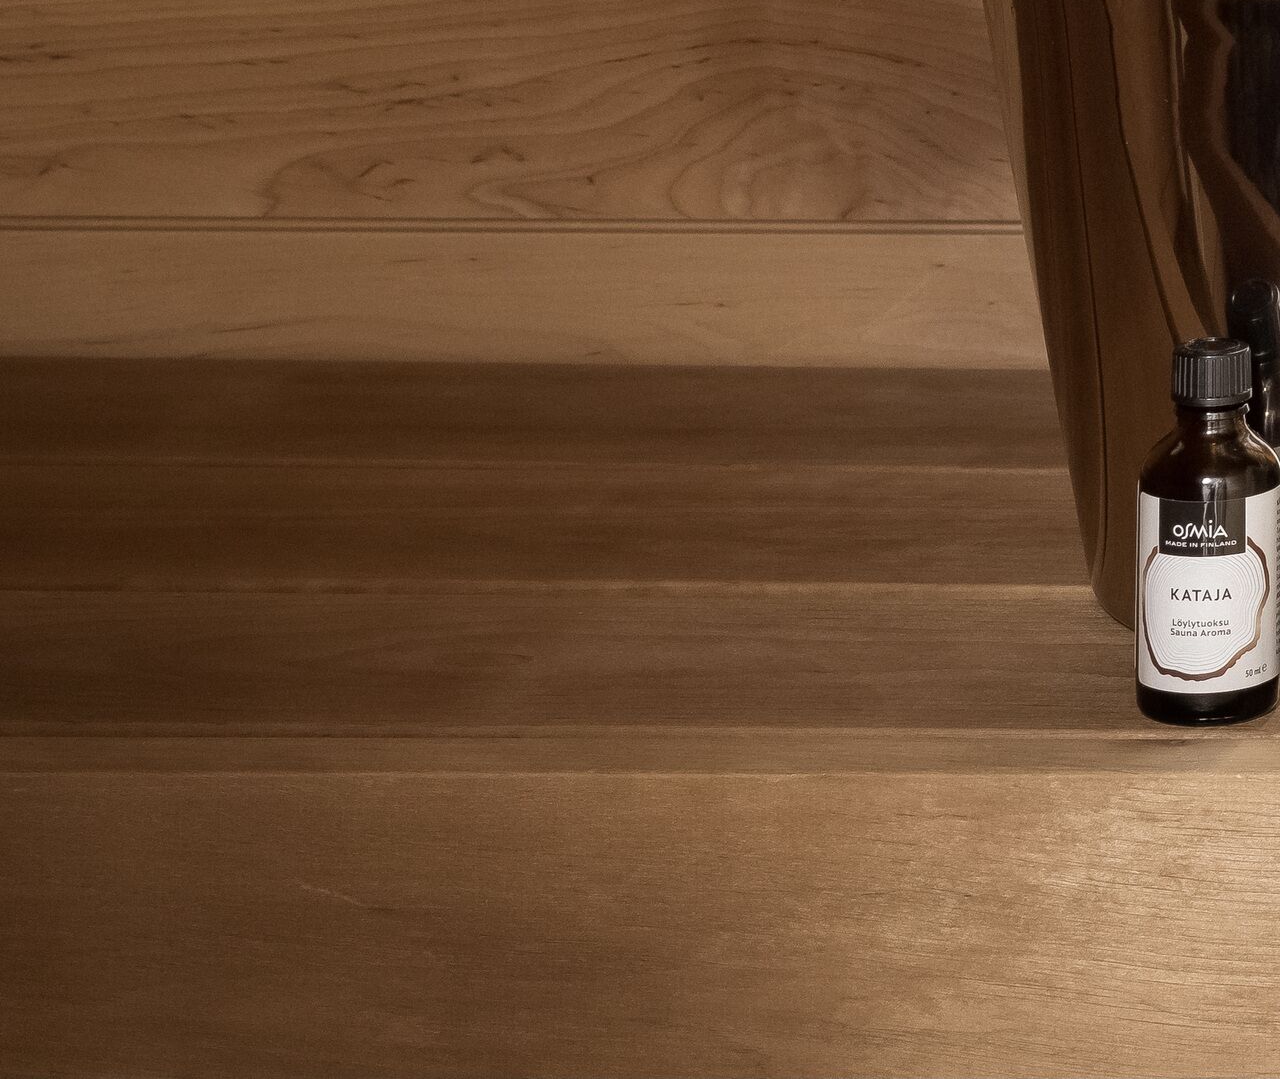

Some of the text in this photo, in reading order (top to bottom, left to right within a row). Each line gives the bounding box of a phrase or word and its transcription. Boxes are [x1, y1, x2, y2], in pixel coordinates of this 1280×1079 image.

[1165, 540, 1187, 548] MADE
[1200, 540, 1237, 548] FINLAND
[1171, 588, 1232, 601] KATAJA
[1172, 618, 1229, 629] Löylytuoksu
[1170, 628, 1231, 637] Sauna Aroma
[1245, 668, 1254, 678] 50
